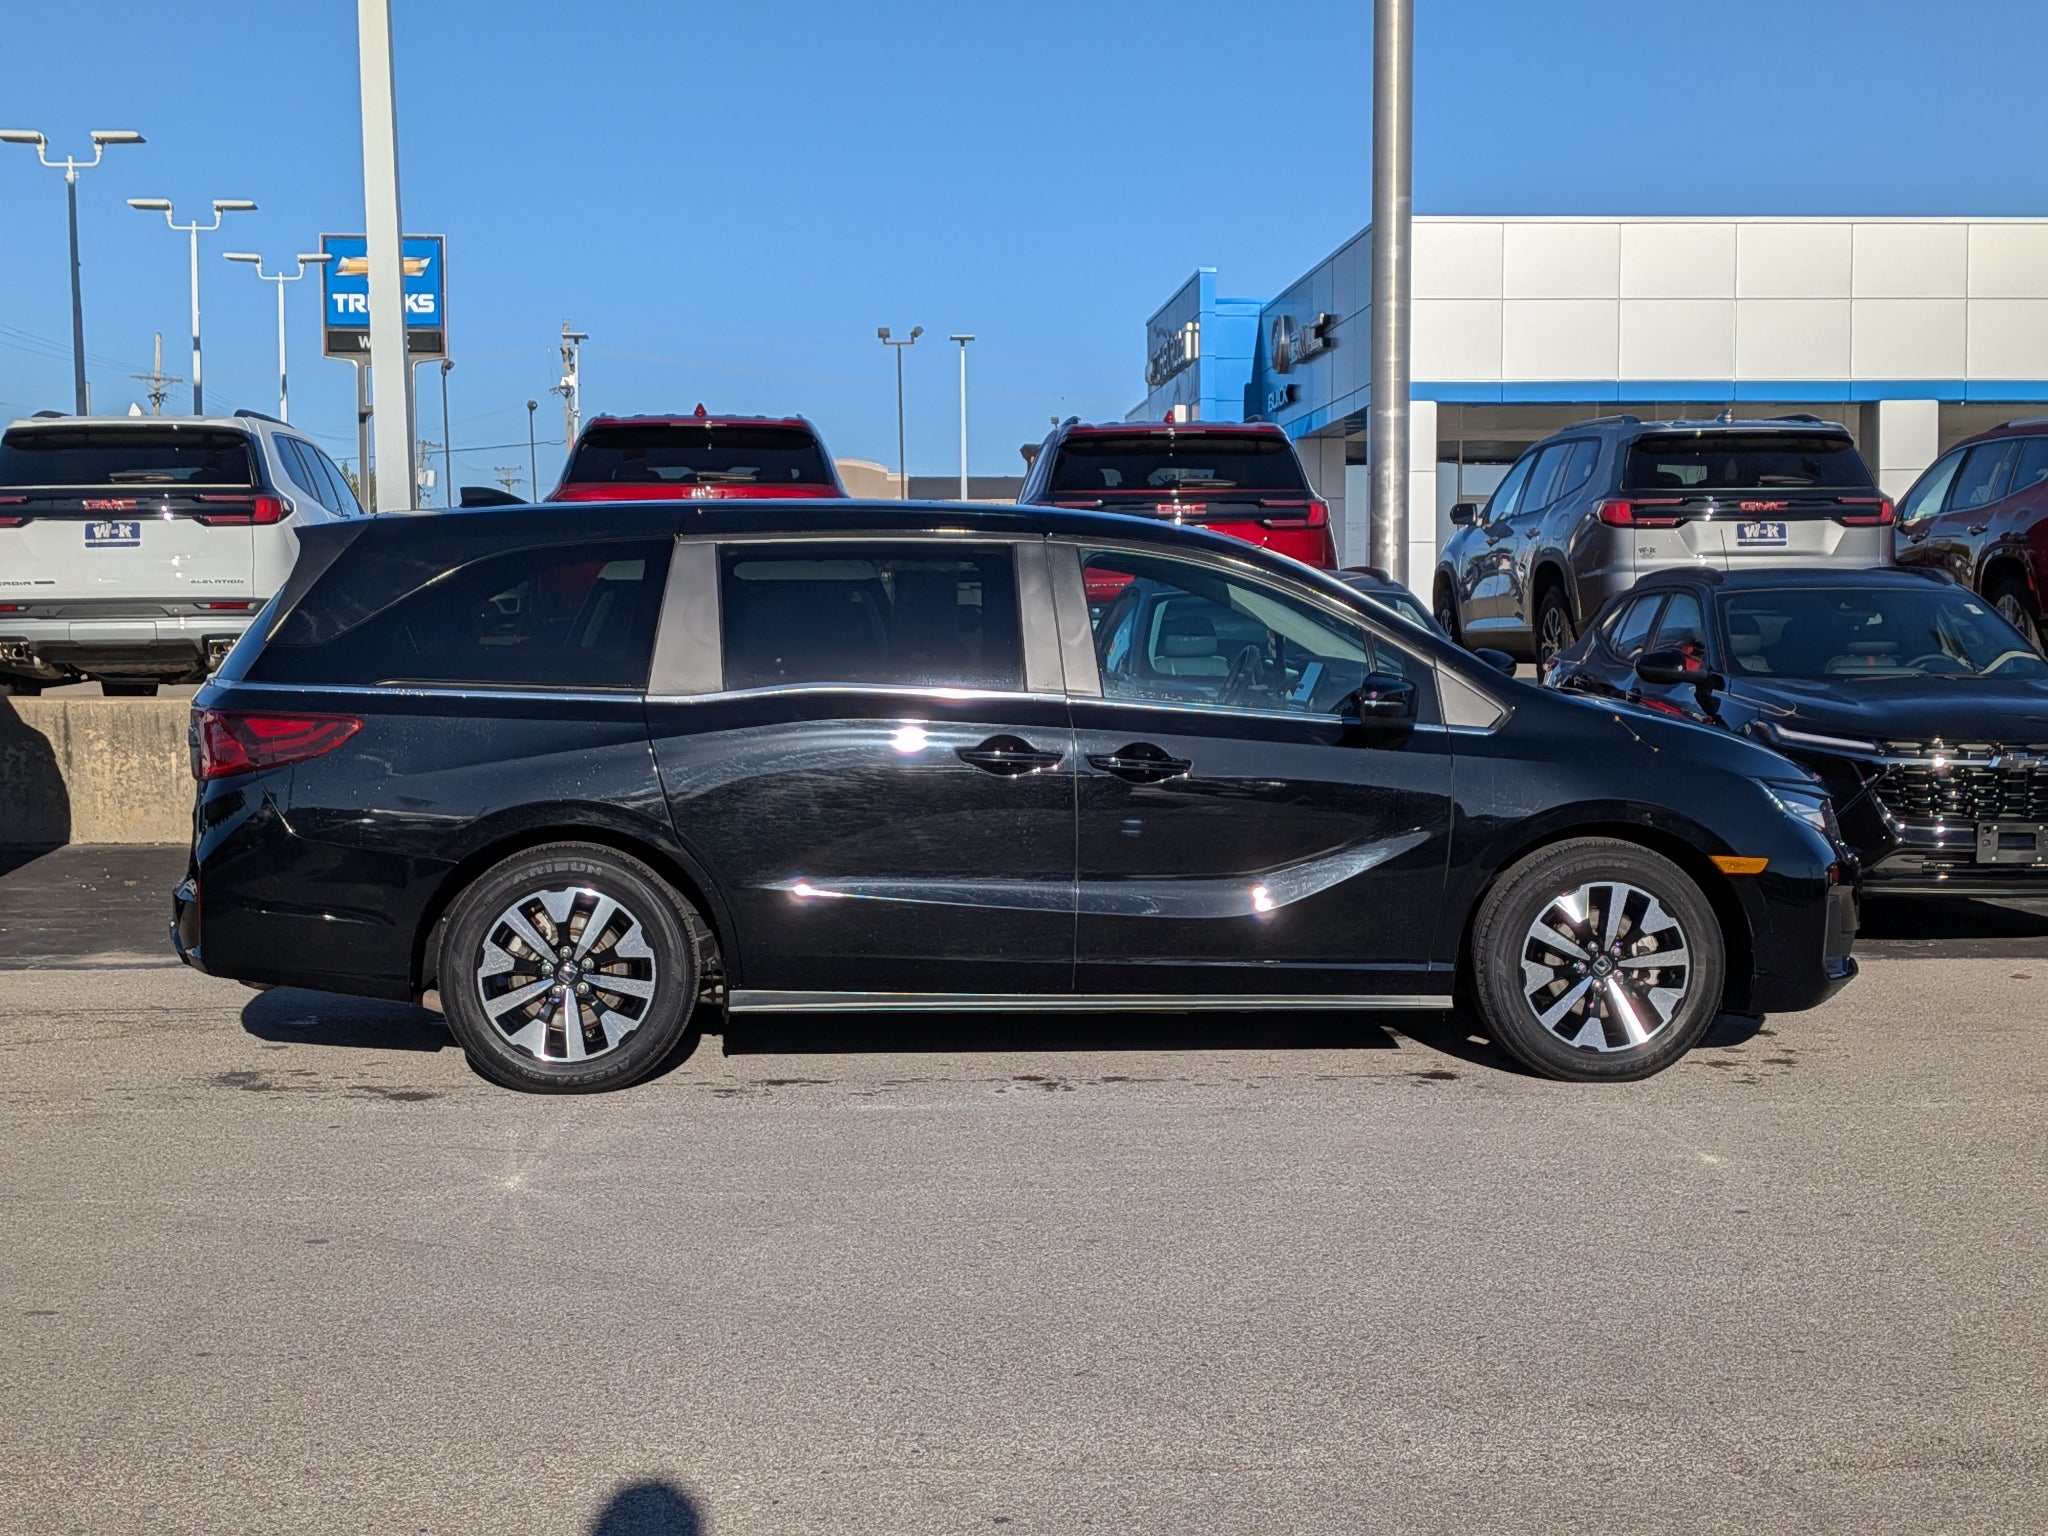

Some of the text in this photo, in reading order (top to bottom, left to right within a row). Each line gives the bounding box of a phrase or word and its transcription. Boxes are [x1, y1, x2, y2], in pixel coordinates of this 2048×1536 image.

[332, 293, 435, 313] TRKS
[1740, 501, 1788, 511] GMC
[93, 523, 133, 539] W-K
[1744, 523, 1780, 538] W-K
[512, 862, 602, 885] ARISUN
